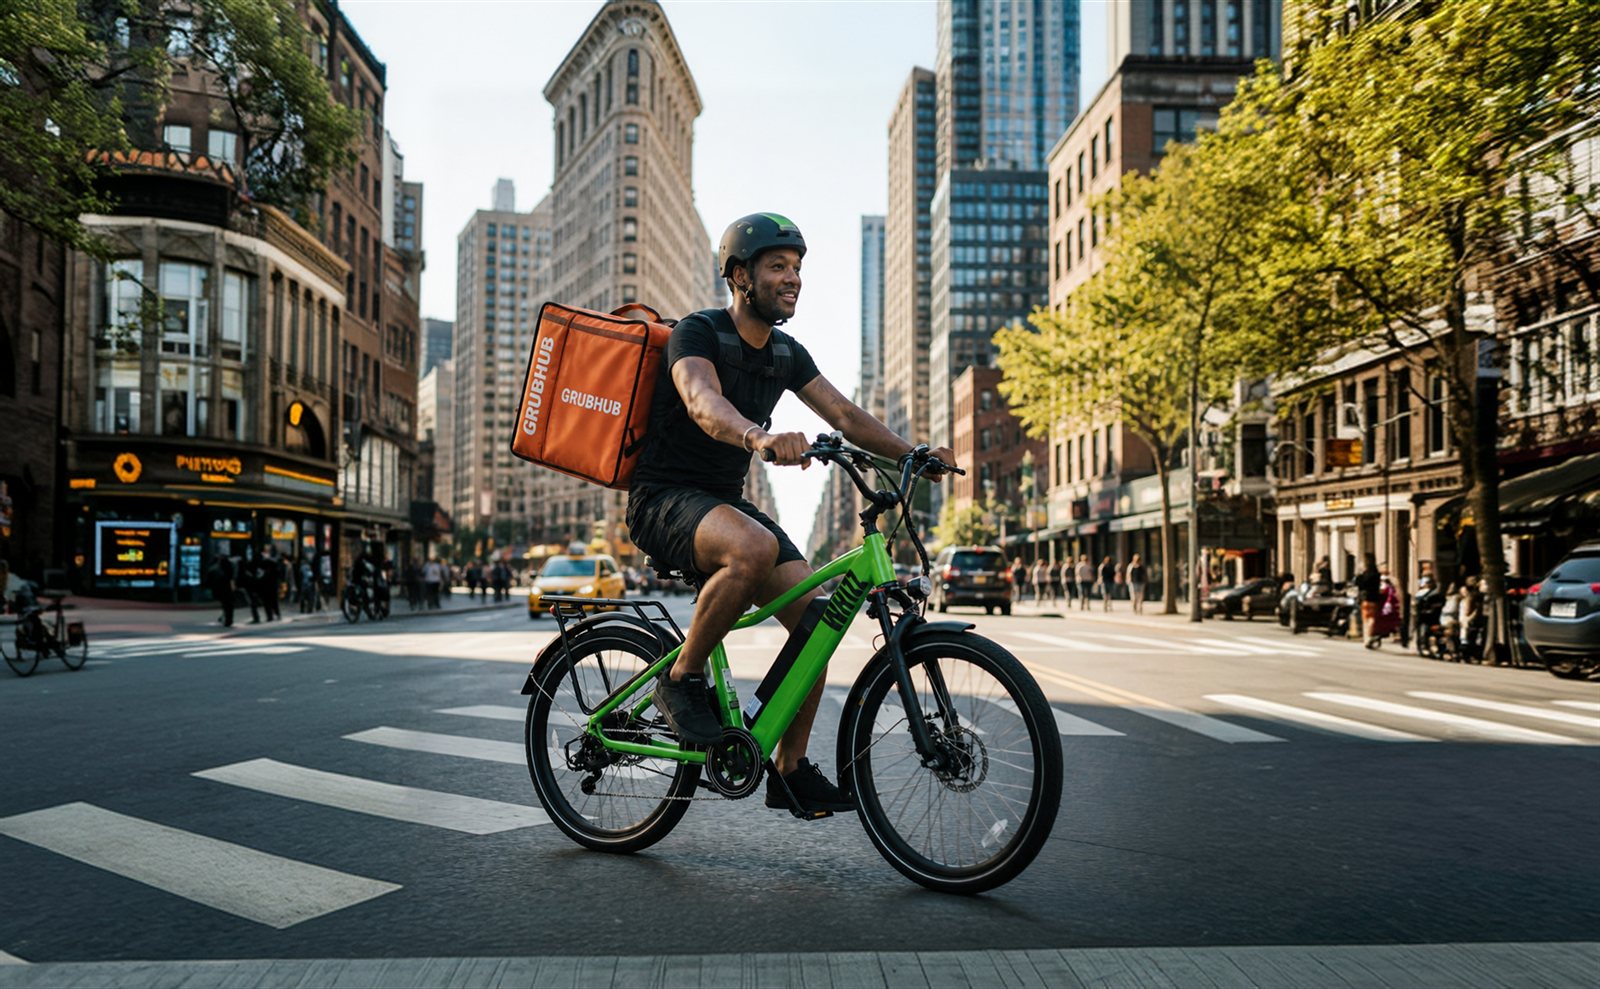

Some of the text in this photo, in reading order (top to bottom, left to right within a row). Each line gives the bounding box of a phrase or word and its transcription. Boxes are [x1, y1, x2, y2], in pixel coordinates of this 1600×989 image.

[523, 336, 554, 435] GRUBHUB
[561, 388, 621, 416] GRUBHUB
[821, 569, 868, 632] WHIZZ
